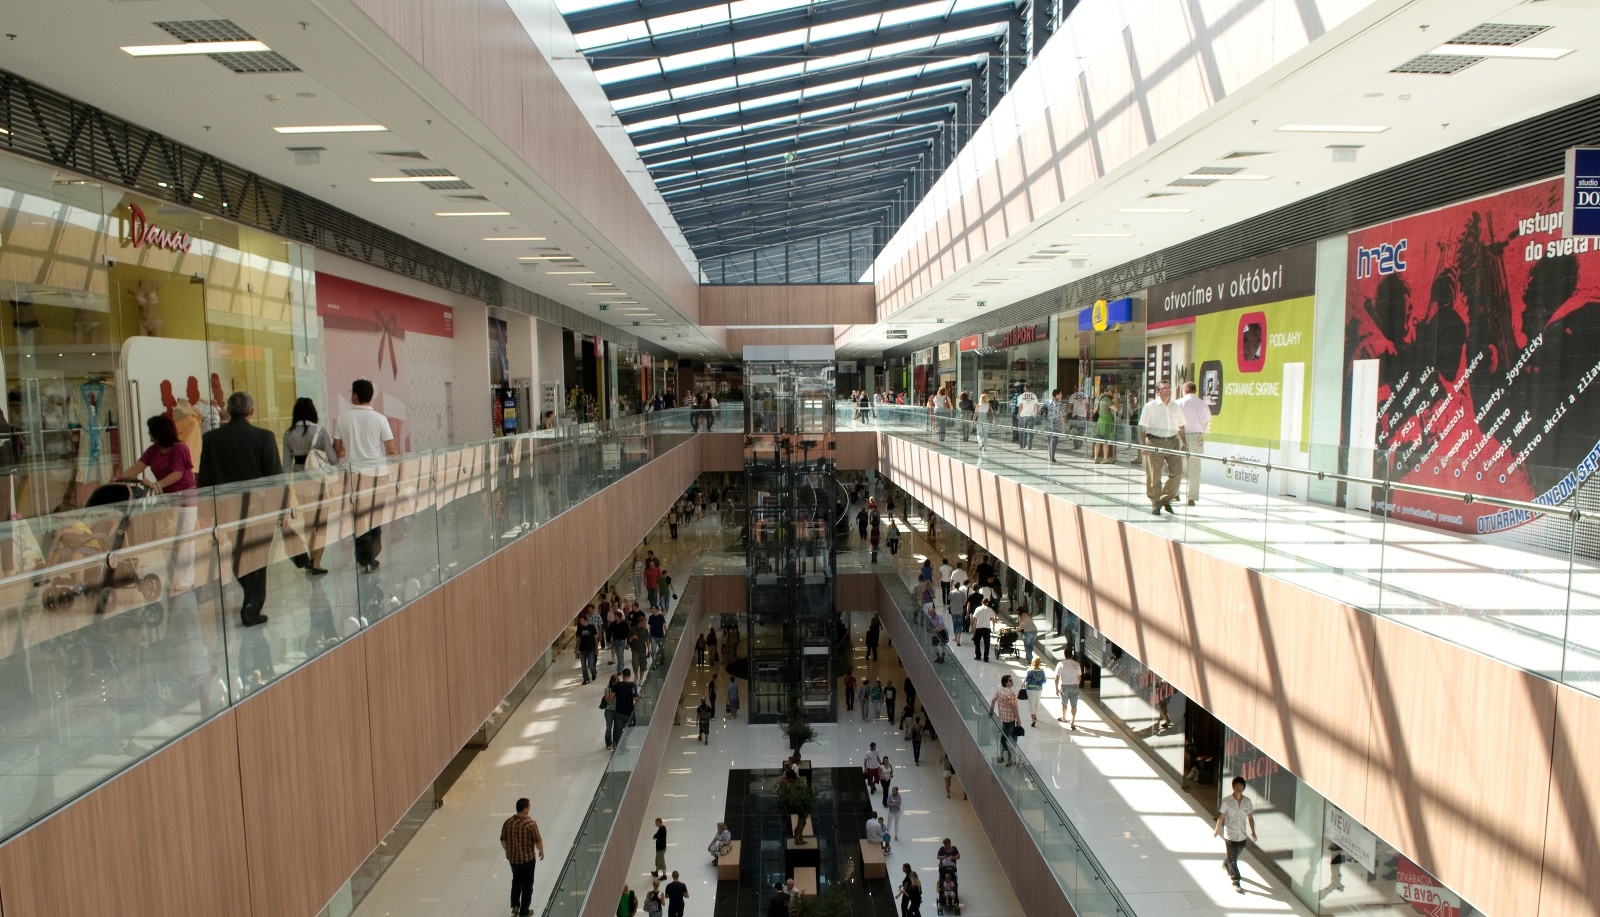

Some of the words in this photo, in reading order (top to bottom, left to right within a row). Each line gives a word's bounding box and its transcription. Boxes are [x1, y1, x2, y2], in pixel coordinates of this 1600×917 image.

[1525, 240, 1543, 262] do
[1546, 237, 1589, 259] sveta
[1164, 278, 1213, 312] otvoríme
[1217, 282, 1224, 300] v
[1230, 264, 1283, 298] októbri
[1012, 324, 1036, 345] SPORT
[1269, 331, 1303, 347] PODLAHY
[1224, 380, 1255, 396] VSTAVANÉ
[1255, 382, 1280, 396] SKRINE
[1423, 392, 1454, 436] sortiment
[1453, 351, 1484, 393] hardvéru
[1473, 387, 1505, 425] volanty,
[1505, 332, 1545, 386] joysticky
[1376, 391, 1397, 424] rtiment
[1395, 371, 1410, 392] hier
[1388, 412, 1403, 429] PS3,
[1403, 387, 1421, 410] X360,
[1419, 366, 1435, 385] Wii,
[1401, 416, 1416, 438] PS1,
[1415, 400, 1431, 418] PS2,
[1429, 383, 1440, 398] DS
[1420, 438, 1440, 465] herné
[1439, 406, 1465, 441] konzoly
[1506, 433, 1542, 476] množstvo
[1543, 402, 1568, 434] akcií
[1568, 394, 1576, 404] a
[1512, 409, 1533, 438] HRÁČ
[1234, 469, 1260, 484] exterier
[1476, 503, 1532, 535] OTVÁRAME
[1330, 810, 1351, 836] NEW
[1341, 835, 1370, 861] collection
[1396, 870, 1433, 887] OTVÁRACIA
